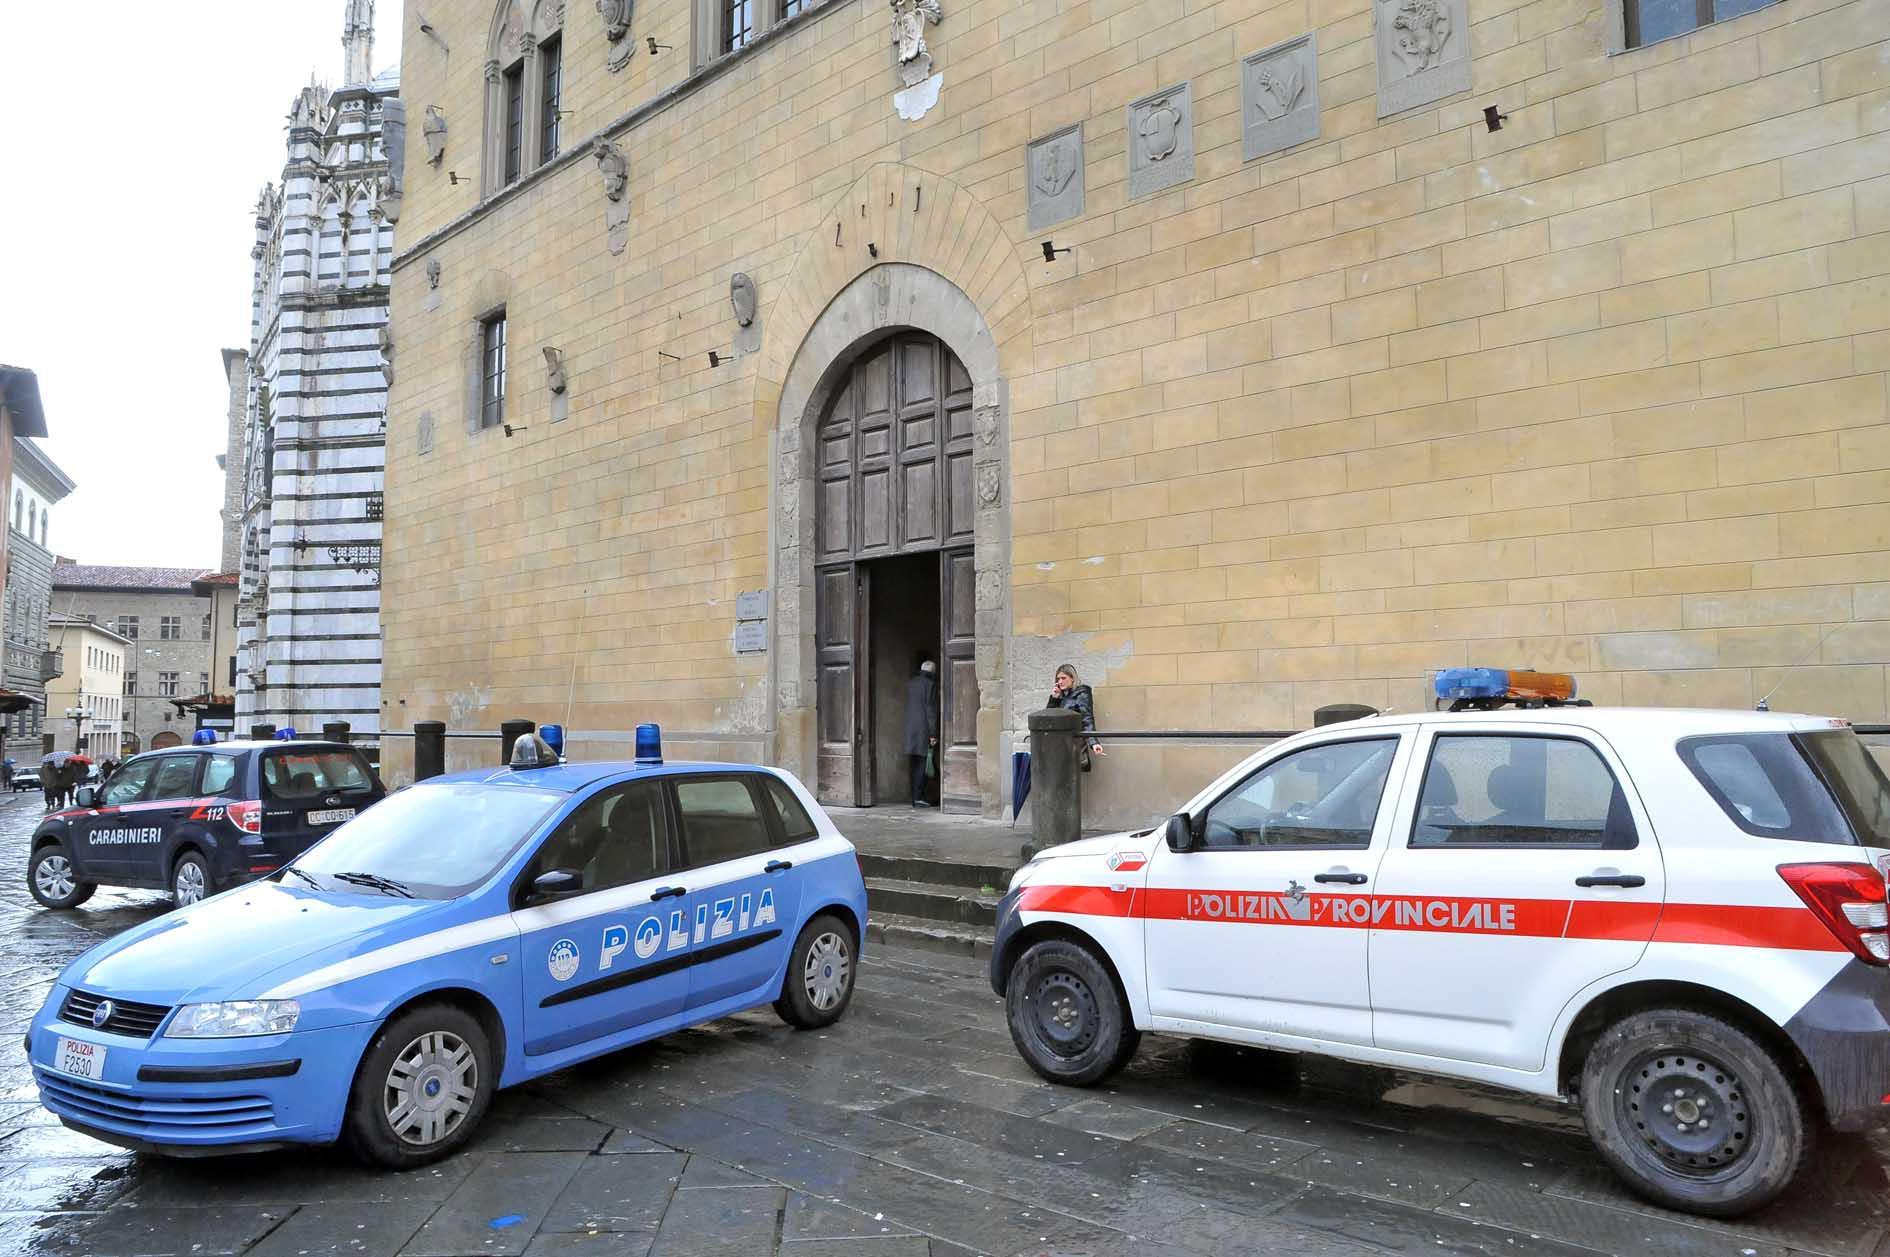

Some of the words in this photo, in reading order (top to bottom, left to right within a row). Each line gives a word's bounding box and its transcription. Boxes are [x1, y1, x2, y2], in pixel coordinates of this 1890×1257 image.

[207, 807, 223, 820] 112
[89, 828, 161, 845] CARABINIERI
[1187, 894, 1288, 920] POLIZIA
[1313, 897, 1516, 930] PROVINCIALE
[599, 888, 776, 970] POLIZIA
[67, 1041, 94, 1056] POLIZIA
[64, 1055, 92, 1076] F2530
